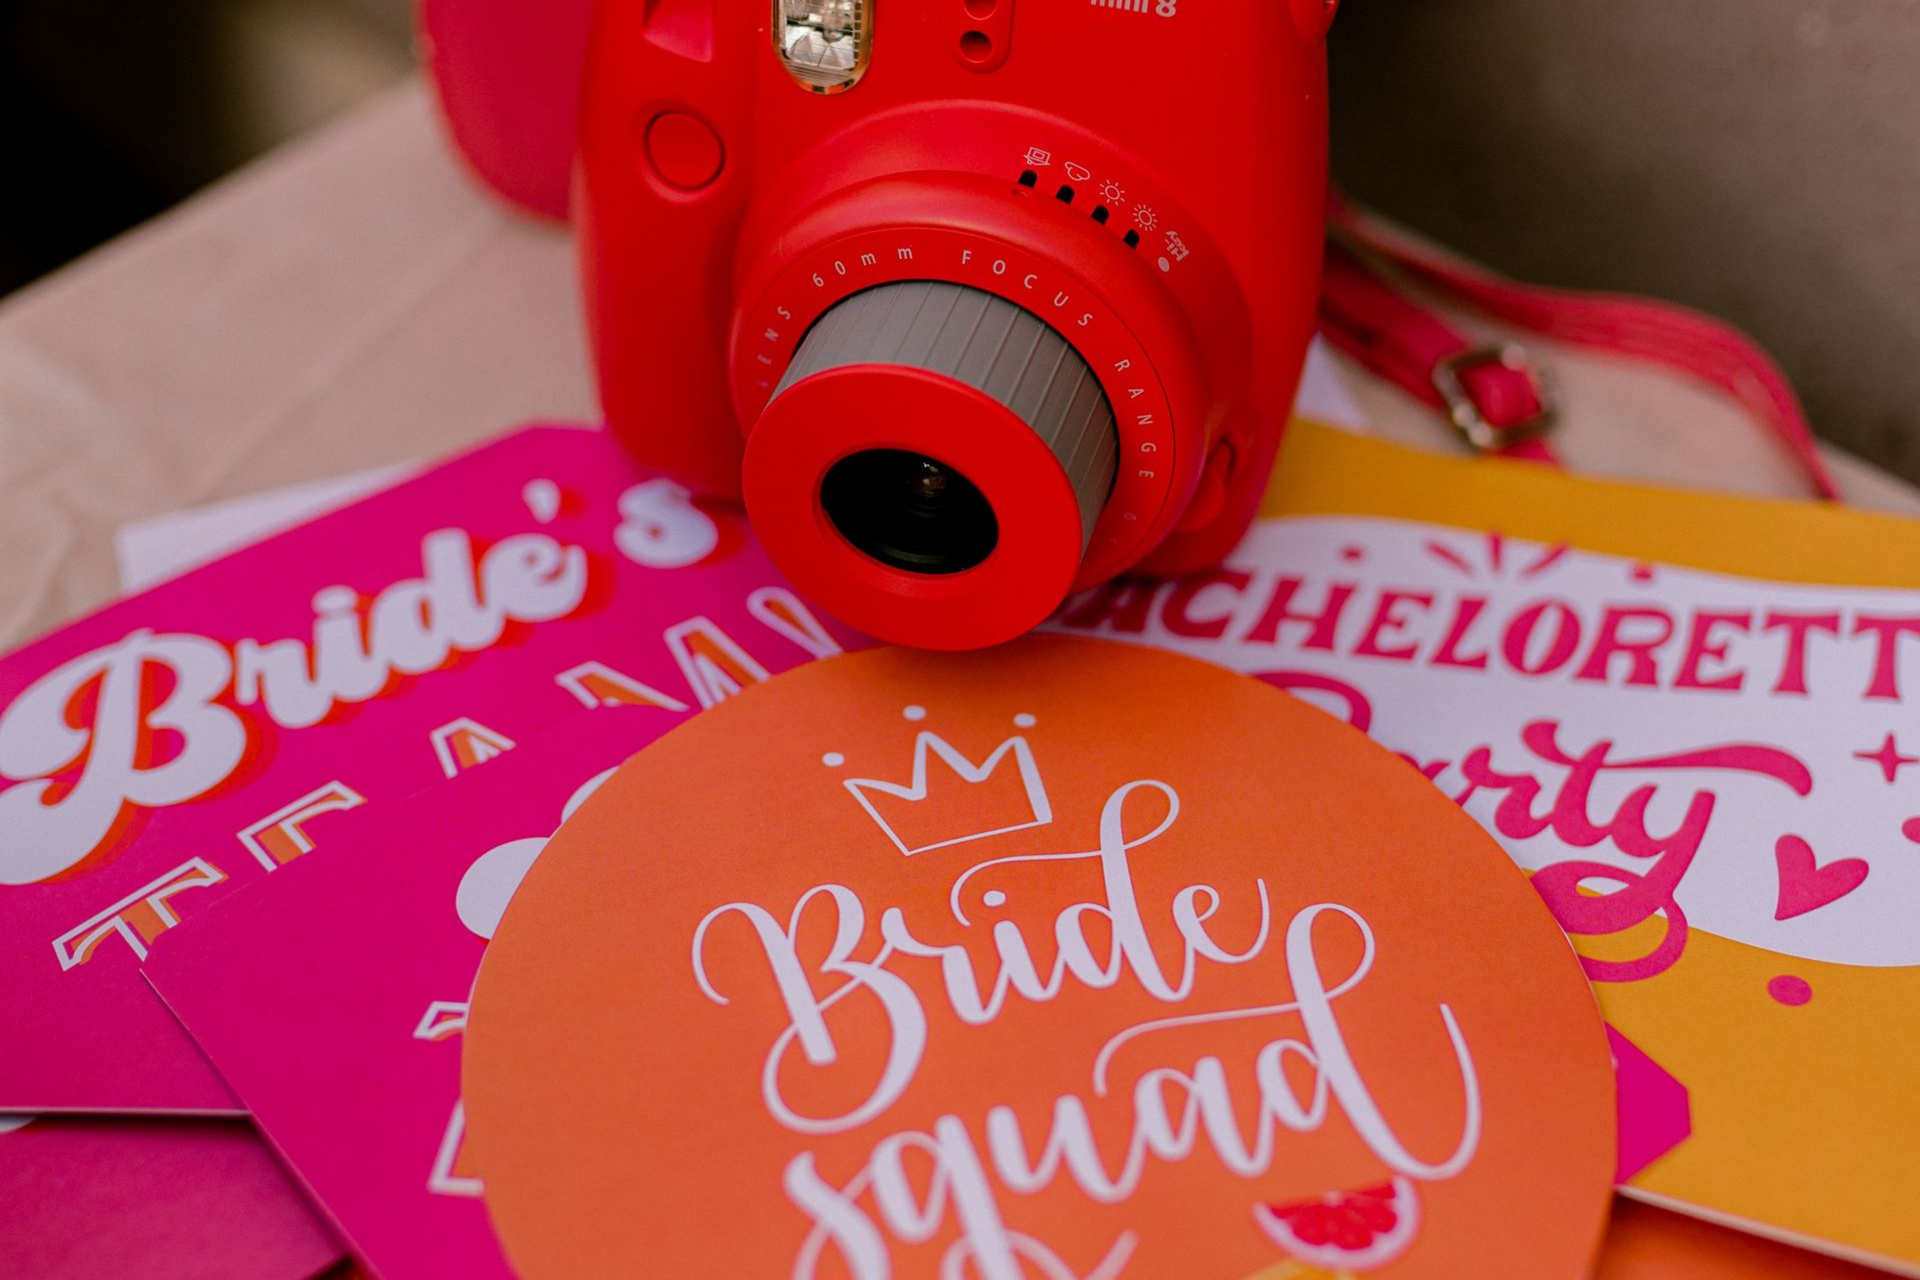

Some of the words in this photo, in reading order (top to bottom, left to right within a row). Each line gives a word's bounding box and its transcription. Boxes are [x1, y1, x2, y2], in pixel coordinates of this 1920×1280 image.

[1155, 0, 1177, 17] 8
[961, 249, 1093, 327] FOCUS
[1114, 358, 1157, 479] RANGE
[0, 477, 719, 885] Bride's
[1058, 567, 1920, 702] ACHELORETT
[691, 779, 1270, 1134] Bride
[783, 902, 1481, 1280] squad
